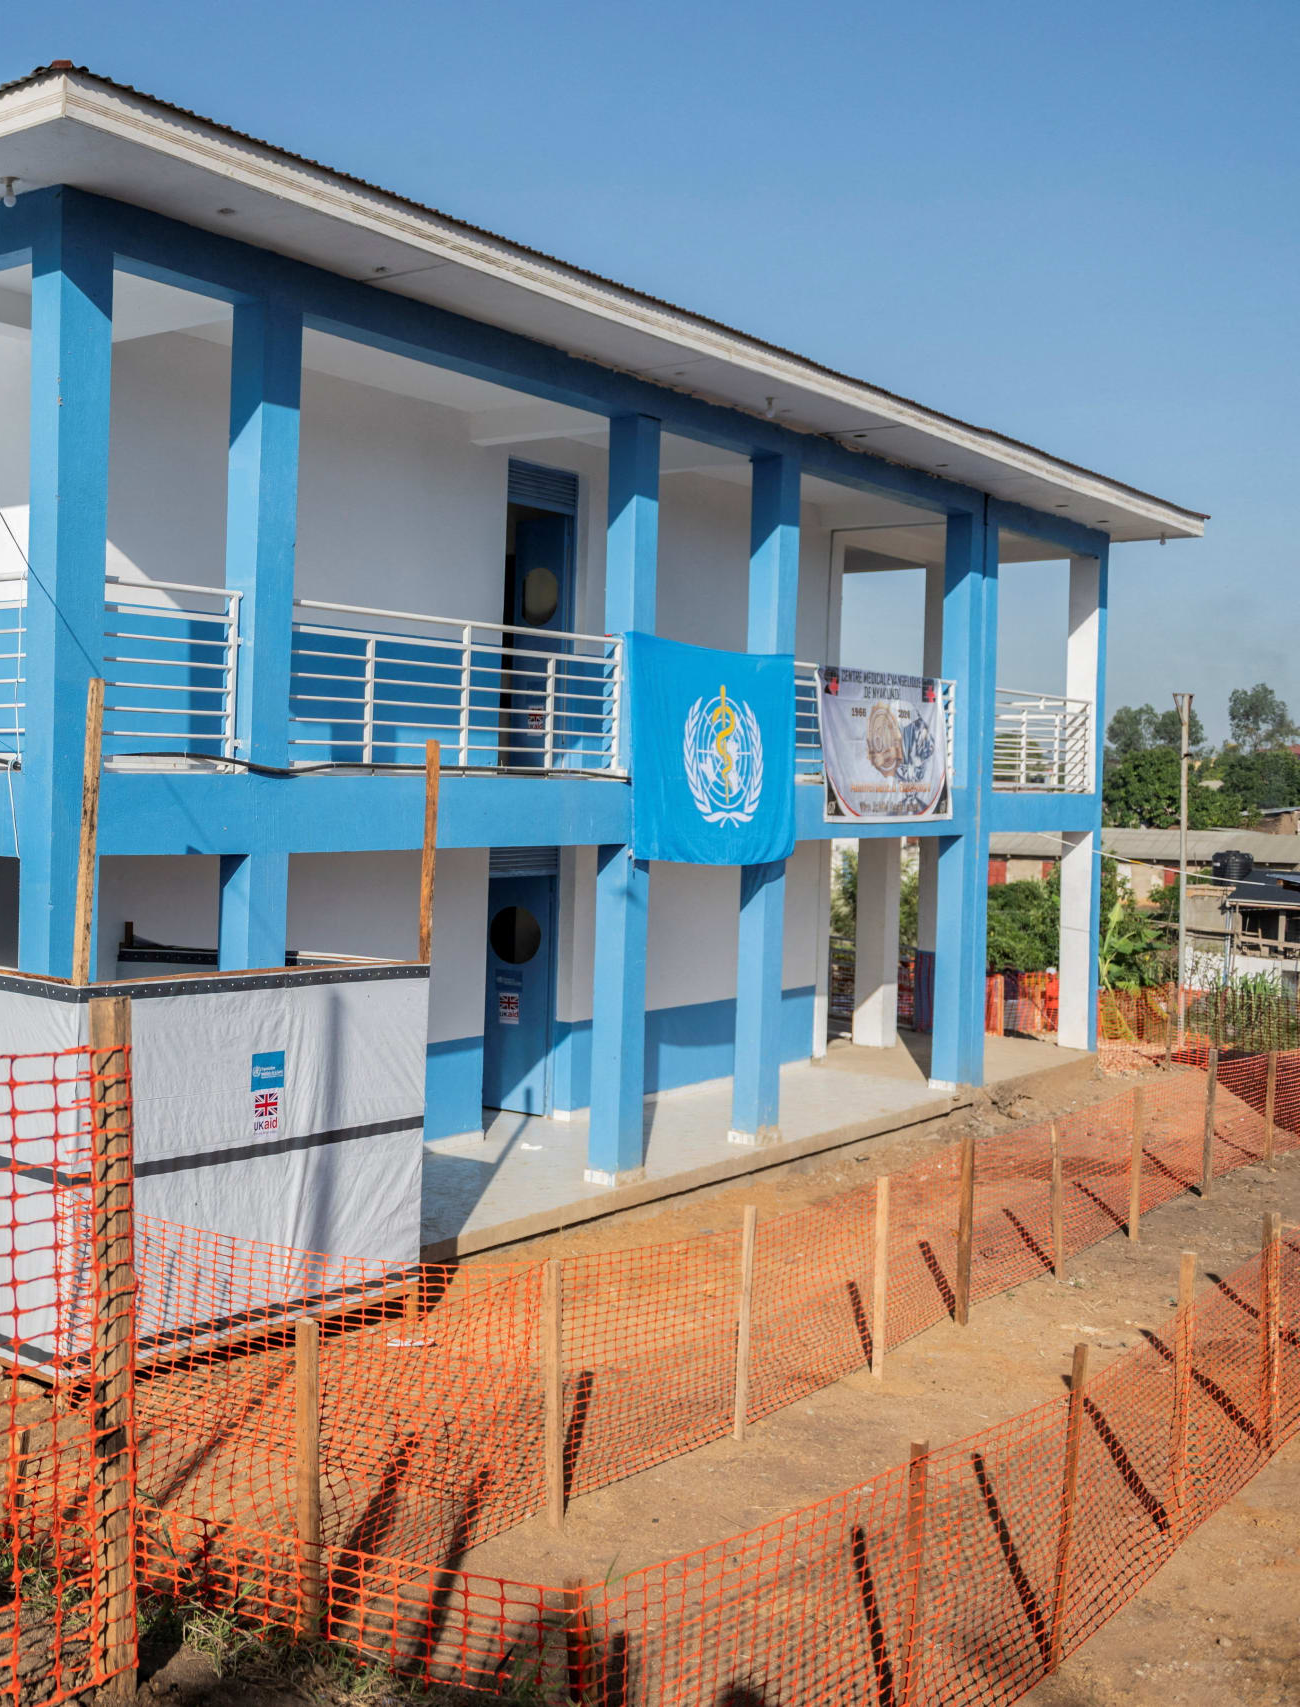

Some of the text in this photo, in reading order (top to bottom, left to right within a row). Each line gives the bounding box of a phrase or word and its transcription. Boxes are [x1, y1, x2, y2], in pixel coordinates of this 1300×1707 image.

[841, 670, 862, 683] CENTRE
[863, 672, 886, 685] MEDICAL
[864, 686, 871, 699] DE
